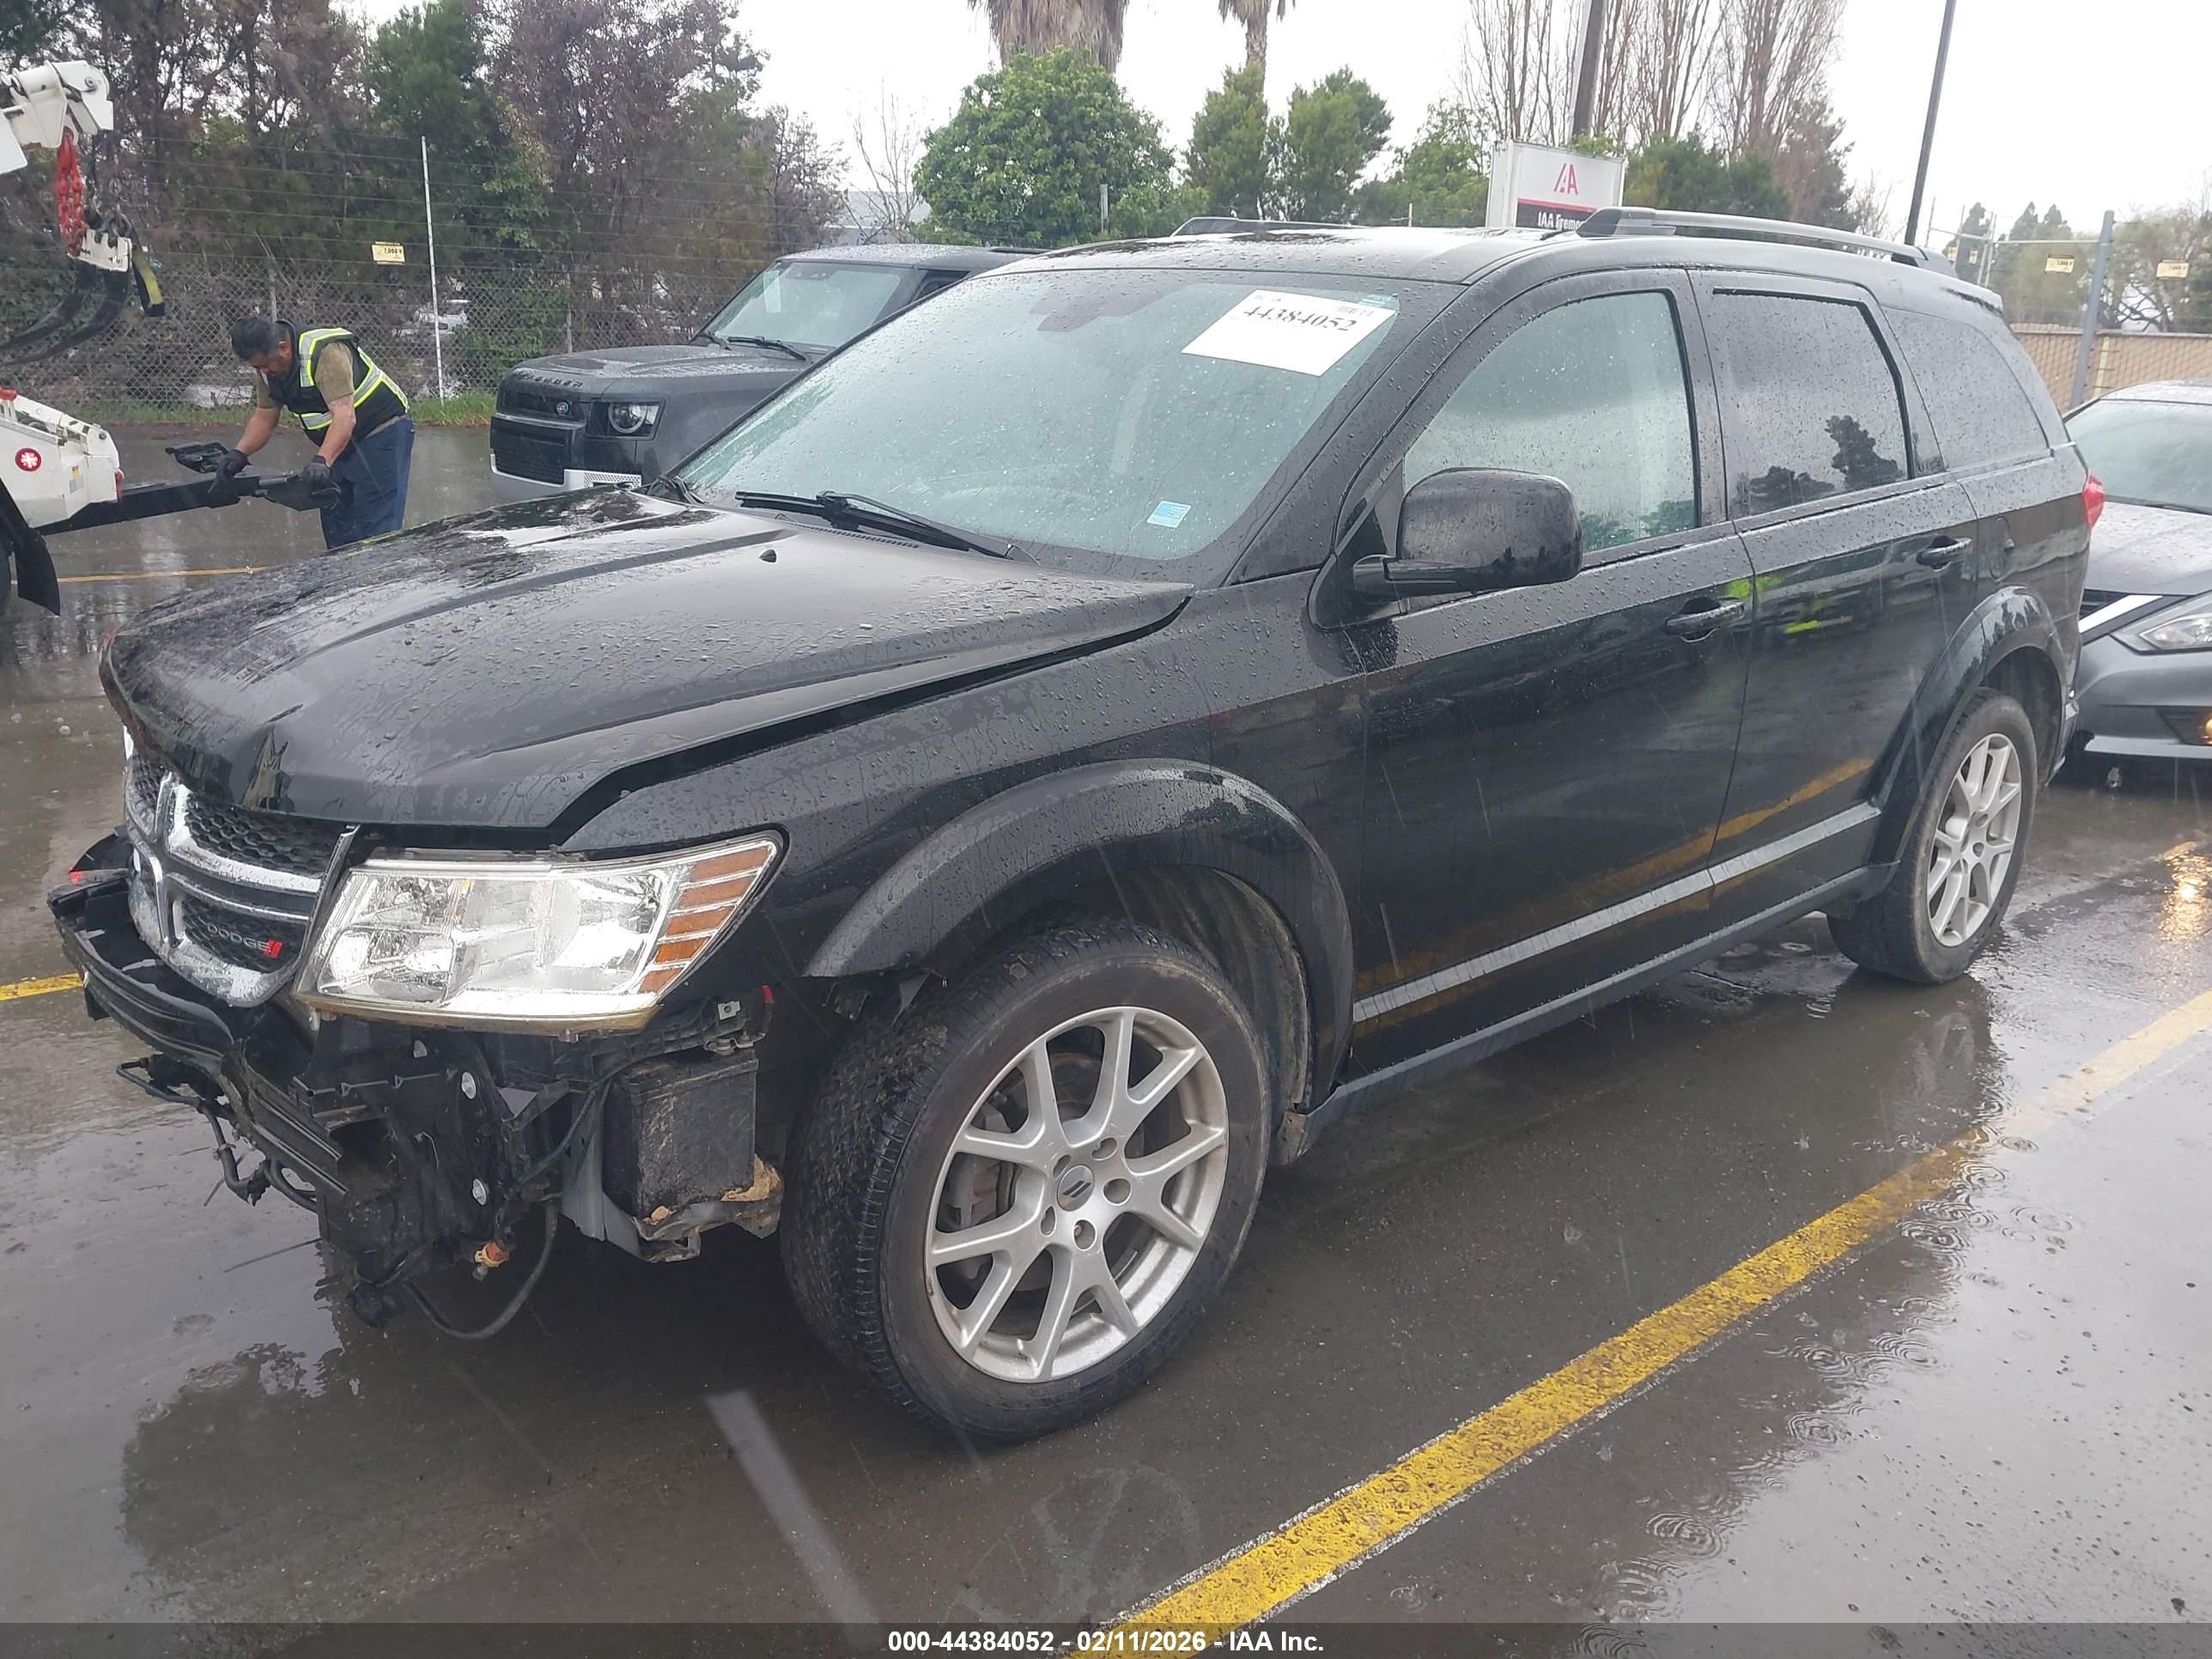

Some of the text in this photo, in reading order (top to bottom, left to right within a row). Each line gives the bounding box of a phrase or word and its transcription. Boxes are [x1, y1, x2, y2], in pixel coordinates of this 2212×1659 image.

[1538, 211, 1553, 228] IAA
[1243, 306, 1358, 331] 44384052
[207, 922, 270, 952] DODGE
